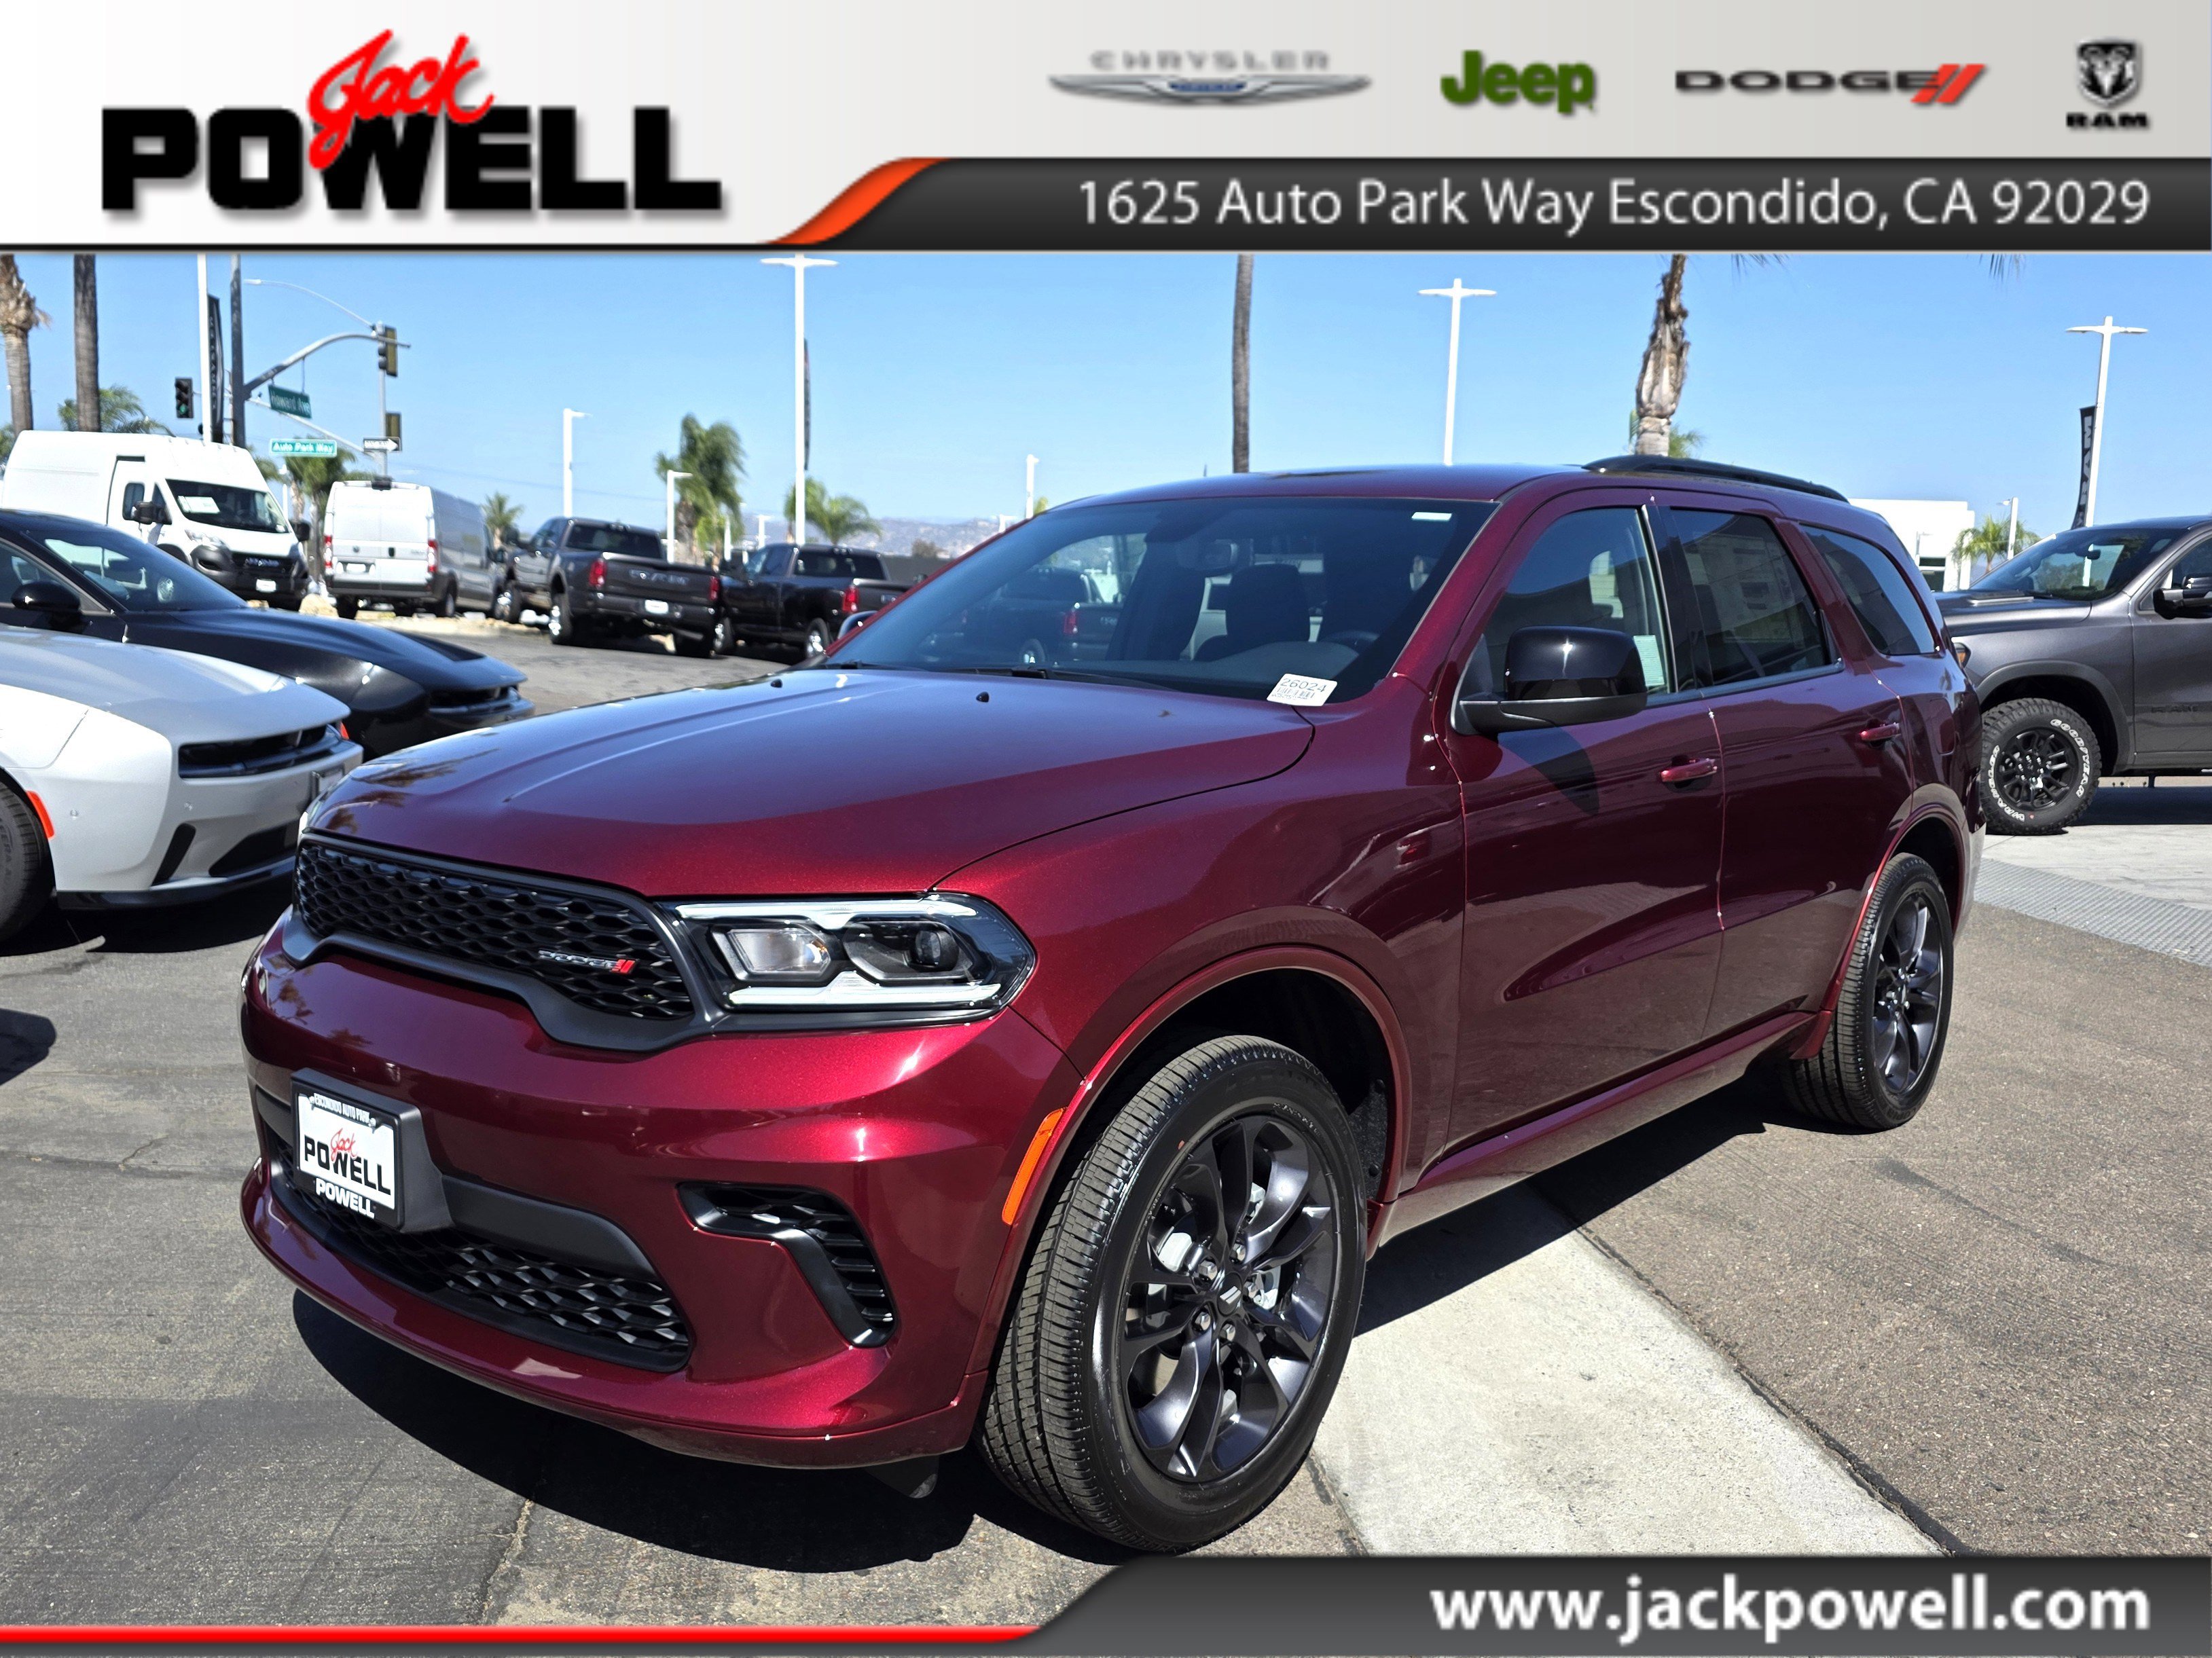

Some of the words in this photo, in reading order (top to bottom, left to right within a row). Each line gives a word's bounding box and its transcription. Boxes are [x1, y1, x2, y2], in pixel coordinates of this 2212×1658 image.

[272, 442, 293, 452] Auto
[295, 443, 314, 452] Park
[317, 443, 333, 454] Way
[2079, 415, 2093, 505] RAM
[1280, 678, 1327, 693] 26024
[538, 950, 621, 972] DODGE
[330, 1128, 358, 1162] Jack
[304, 1134, 391, 1196] POWELL
[316, 1177, 375, 1219] POWELL
